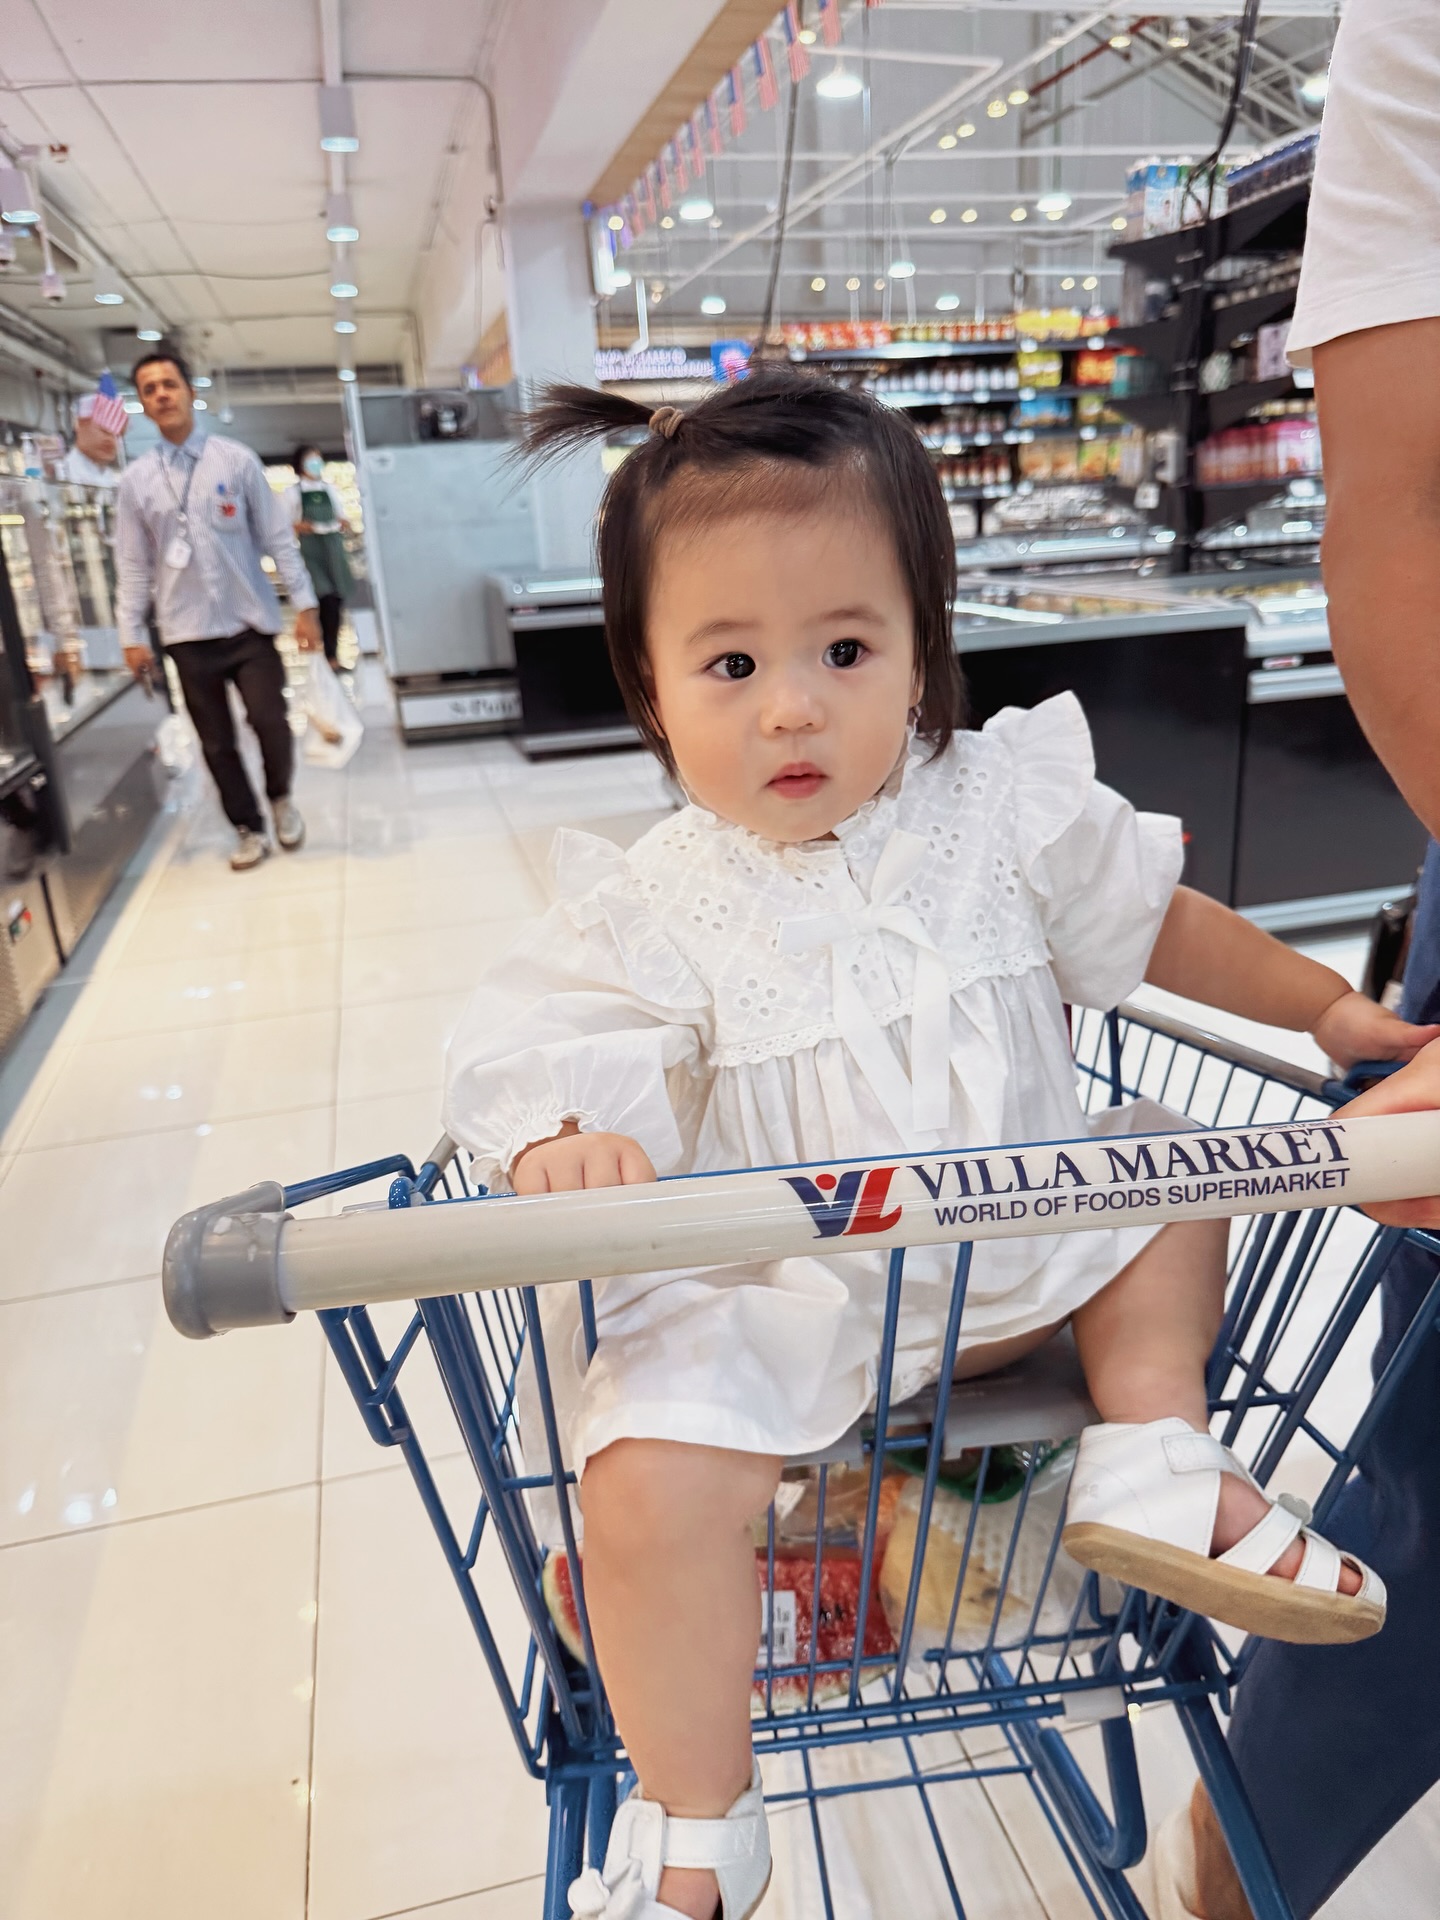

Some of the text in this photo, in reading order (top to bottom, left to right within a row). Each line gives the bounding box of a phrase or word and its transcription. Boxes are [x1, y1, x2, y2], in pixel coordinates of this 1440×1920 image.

[906, 1125, 1348, 1201] VILLA MARKET
[934, 1168, 1350, 1226] WORLD OF FOODS SUPERMARKET
